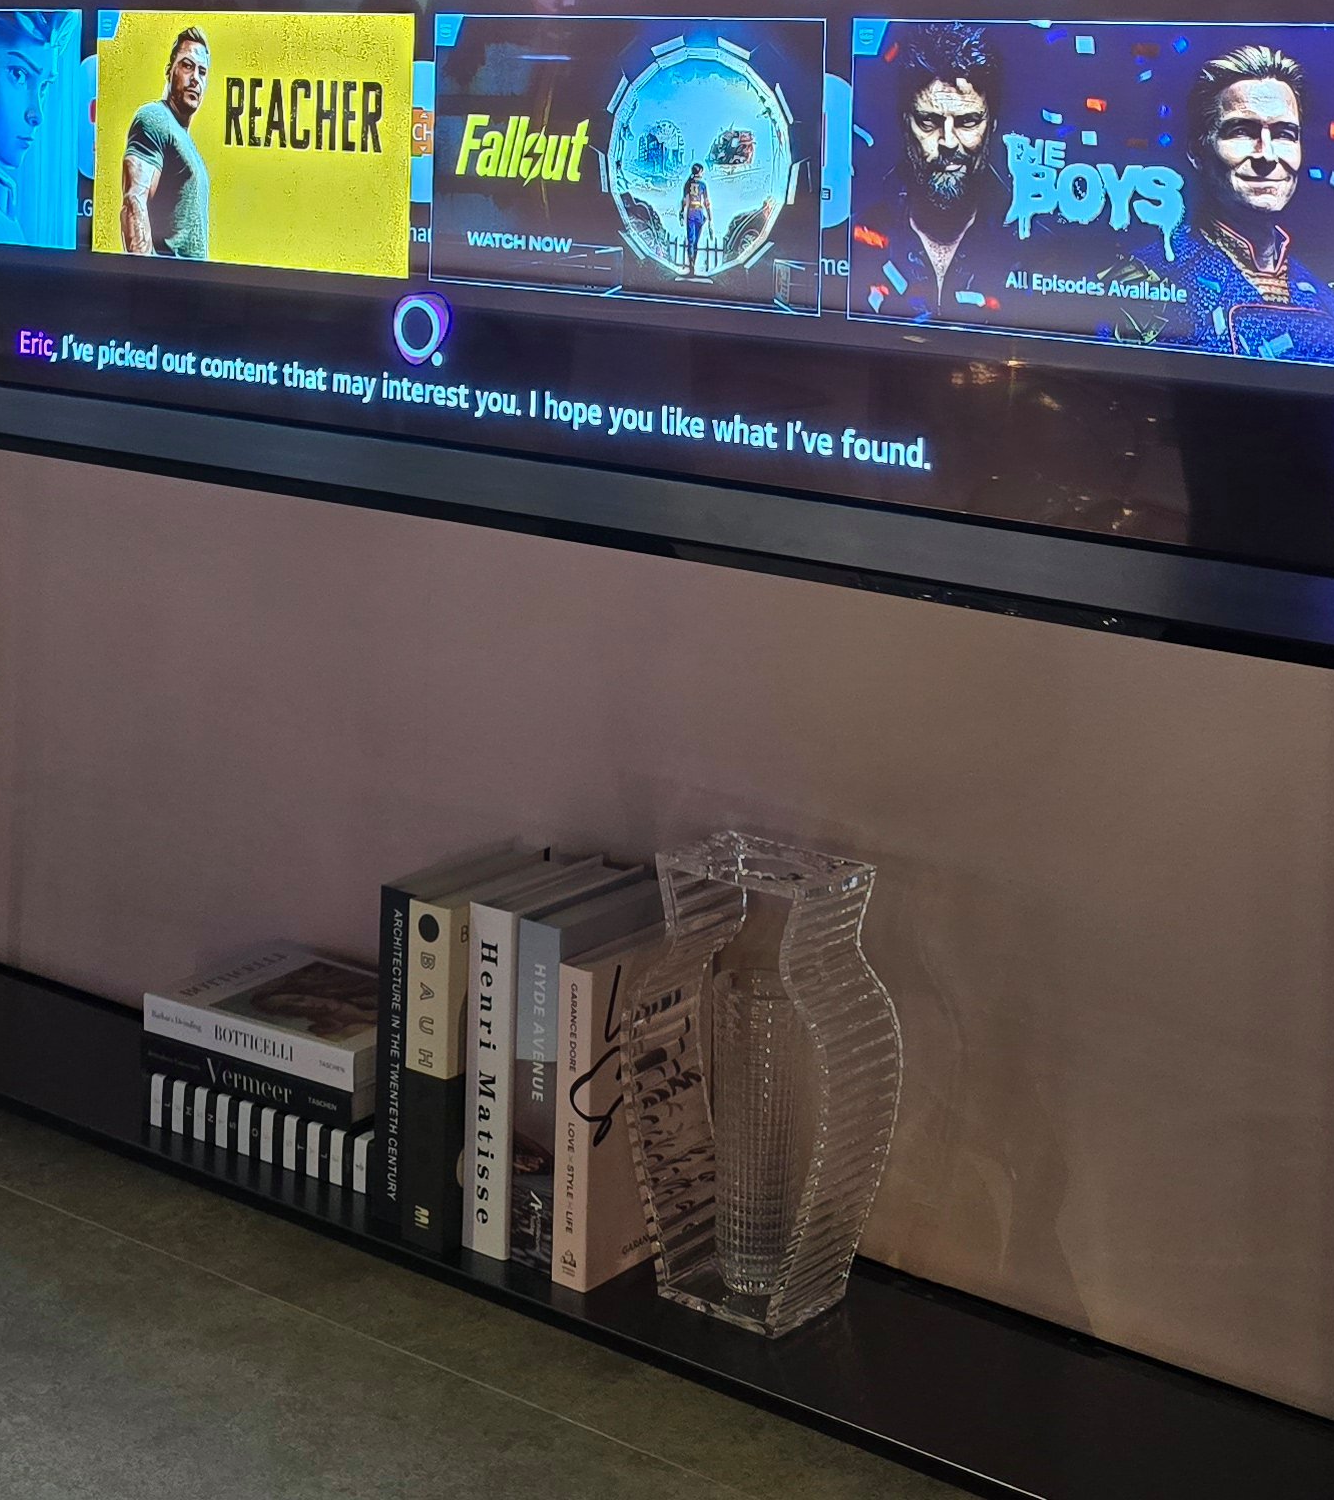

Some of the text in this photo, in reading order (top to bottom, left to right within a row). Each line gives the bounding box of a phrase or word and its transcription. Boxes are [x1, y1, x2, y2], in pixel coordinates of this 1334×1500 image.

[224, 77, 383, 153] REACHER
[455, 113, 590, 187] Fallout
[1004, 162, 1185, 250] BOYS
[467, 230, 572, 253] WATCH NOW
[1005, 270, 1187, 304] All Episodes Available
[19, 331, 932, 470] Eric, I've picked out content that may interest you. I hope you like what I've found.
[391, 909, 404, 1011] ARCHITECTURE
[214, 1024, 294, 1062] BOTTICELLI
[390, 1033, 401, 1058] THE
[391, 1015, 401, 1028] IN
[531, 963, 547, 1102] HYDE AVENUE
[206, 1056, 293, 1105] Vermeer
[308, 1096, 338, 1112] TASCHEN
[474, 941, 500, 1226] Henri Matisse
[386, 1138, 398, 1201] CENTURY
[565, 1122, 576, 1235] LOVE STYLE LIFE
